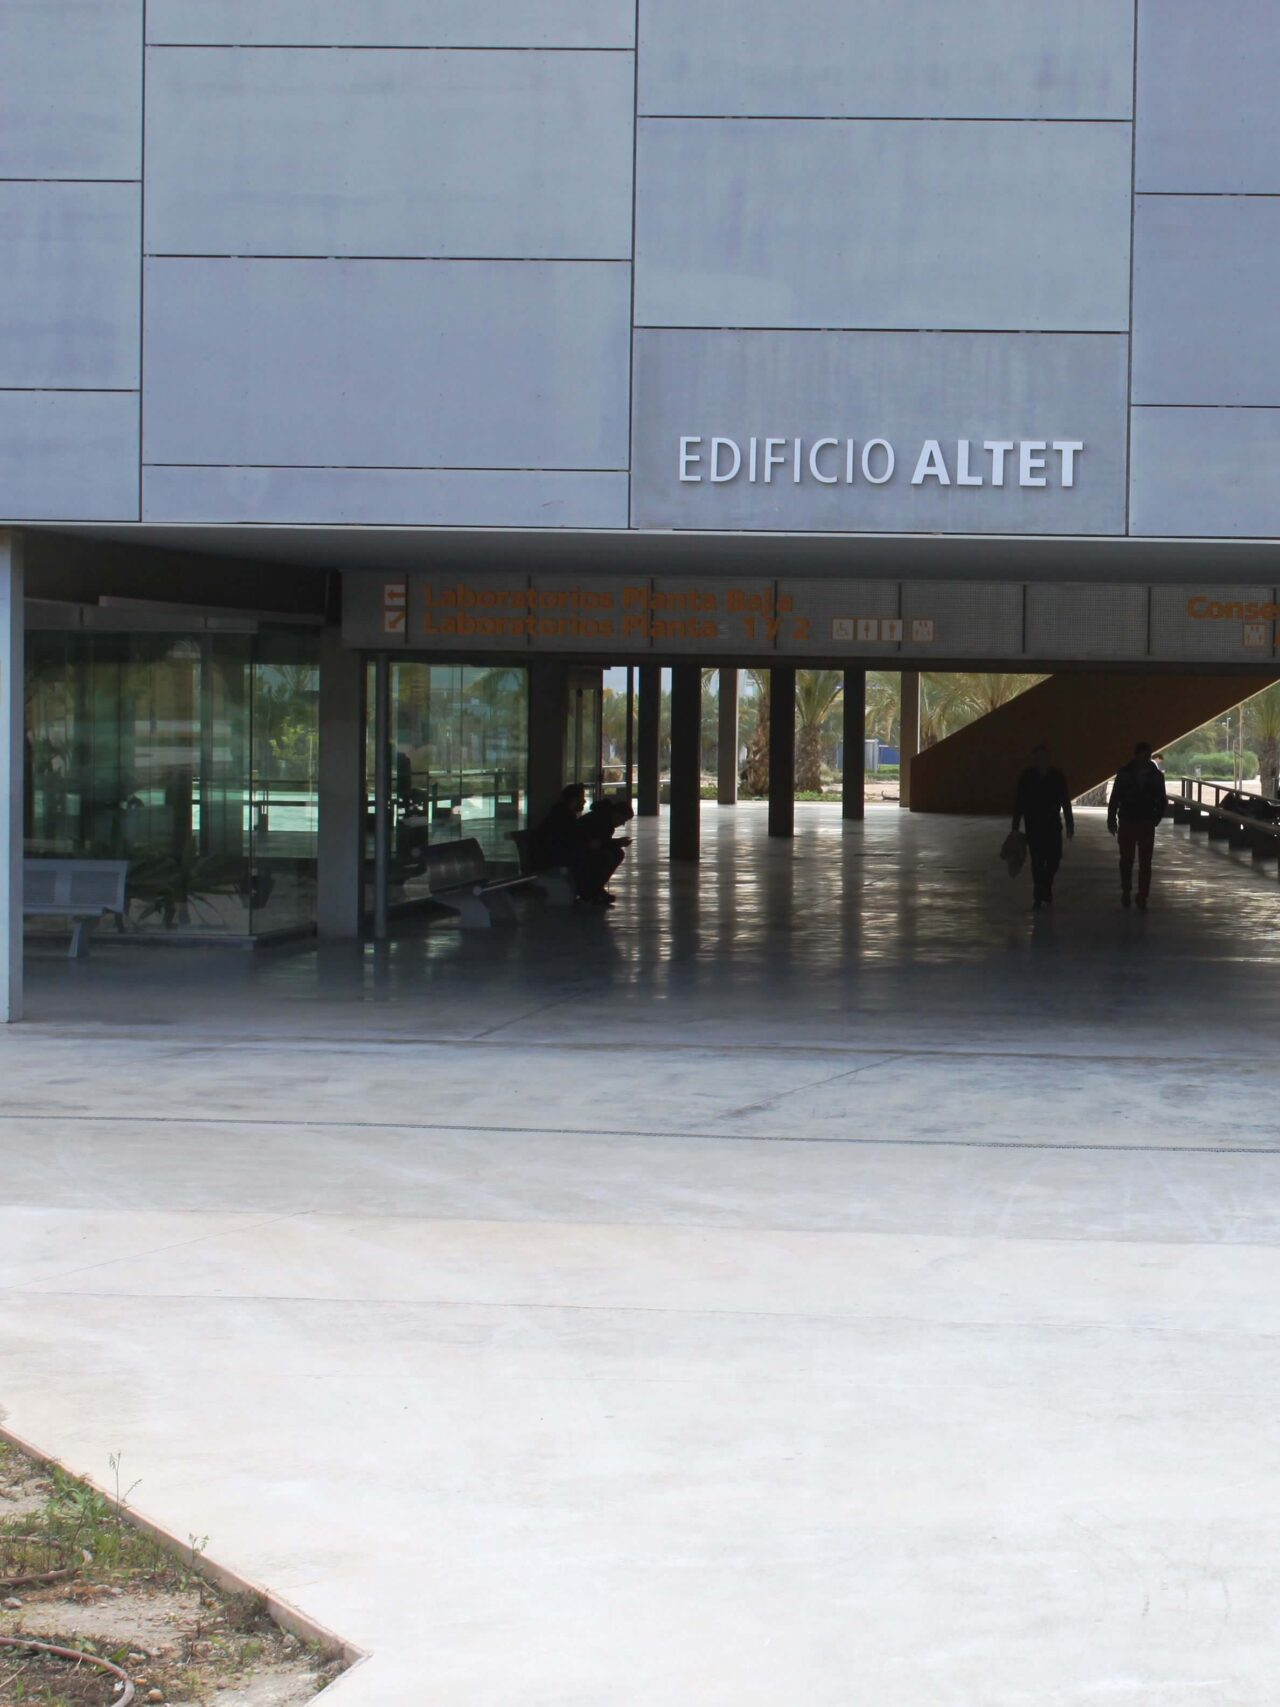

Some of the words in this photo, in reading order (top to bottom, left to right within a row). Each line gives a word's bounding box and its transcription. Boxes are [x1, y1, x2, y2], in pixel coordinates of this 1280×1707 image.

[679, 436, 895, 484] EDIFICIO
[911, 439, 1084, 488] ALTET
[423, 584, 614, 610] Laboratorios
[622, 586, 717, 612] Planta
[726, 588, 793, 618] Baja
[423, 611, 614, 637] Laboratorios
[622, 613, 717, 638] Planta
[741, 616, 755, 639] 1
[792, 616, 811, 641] 2
